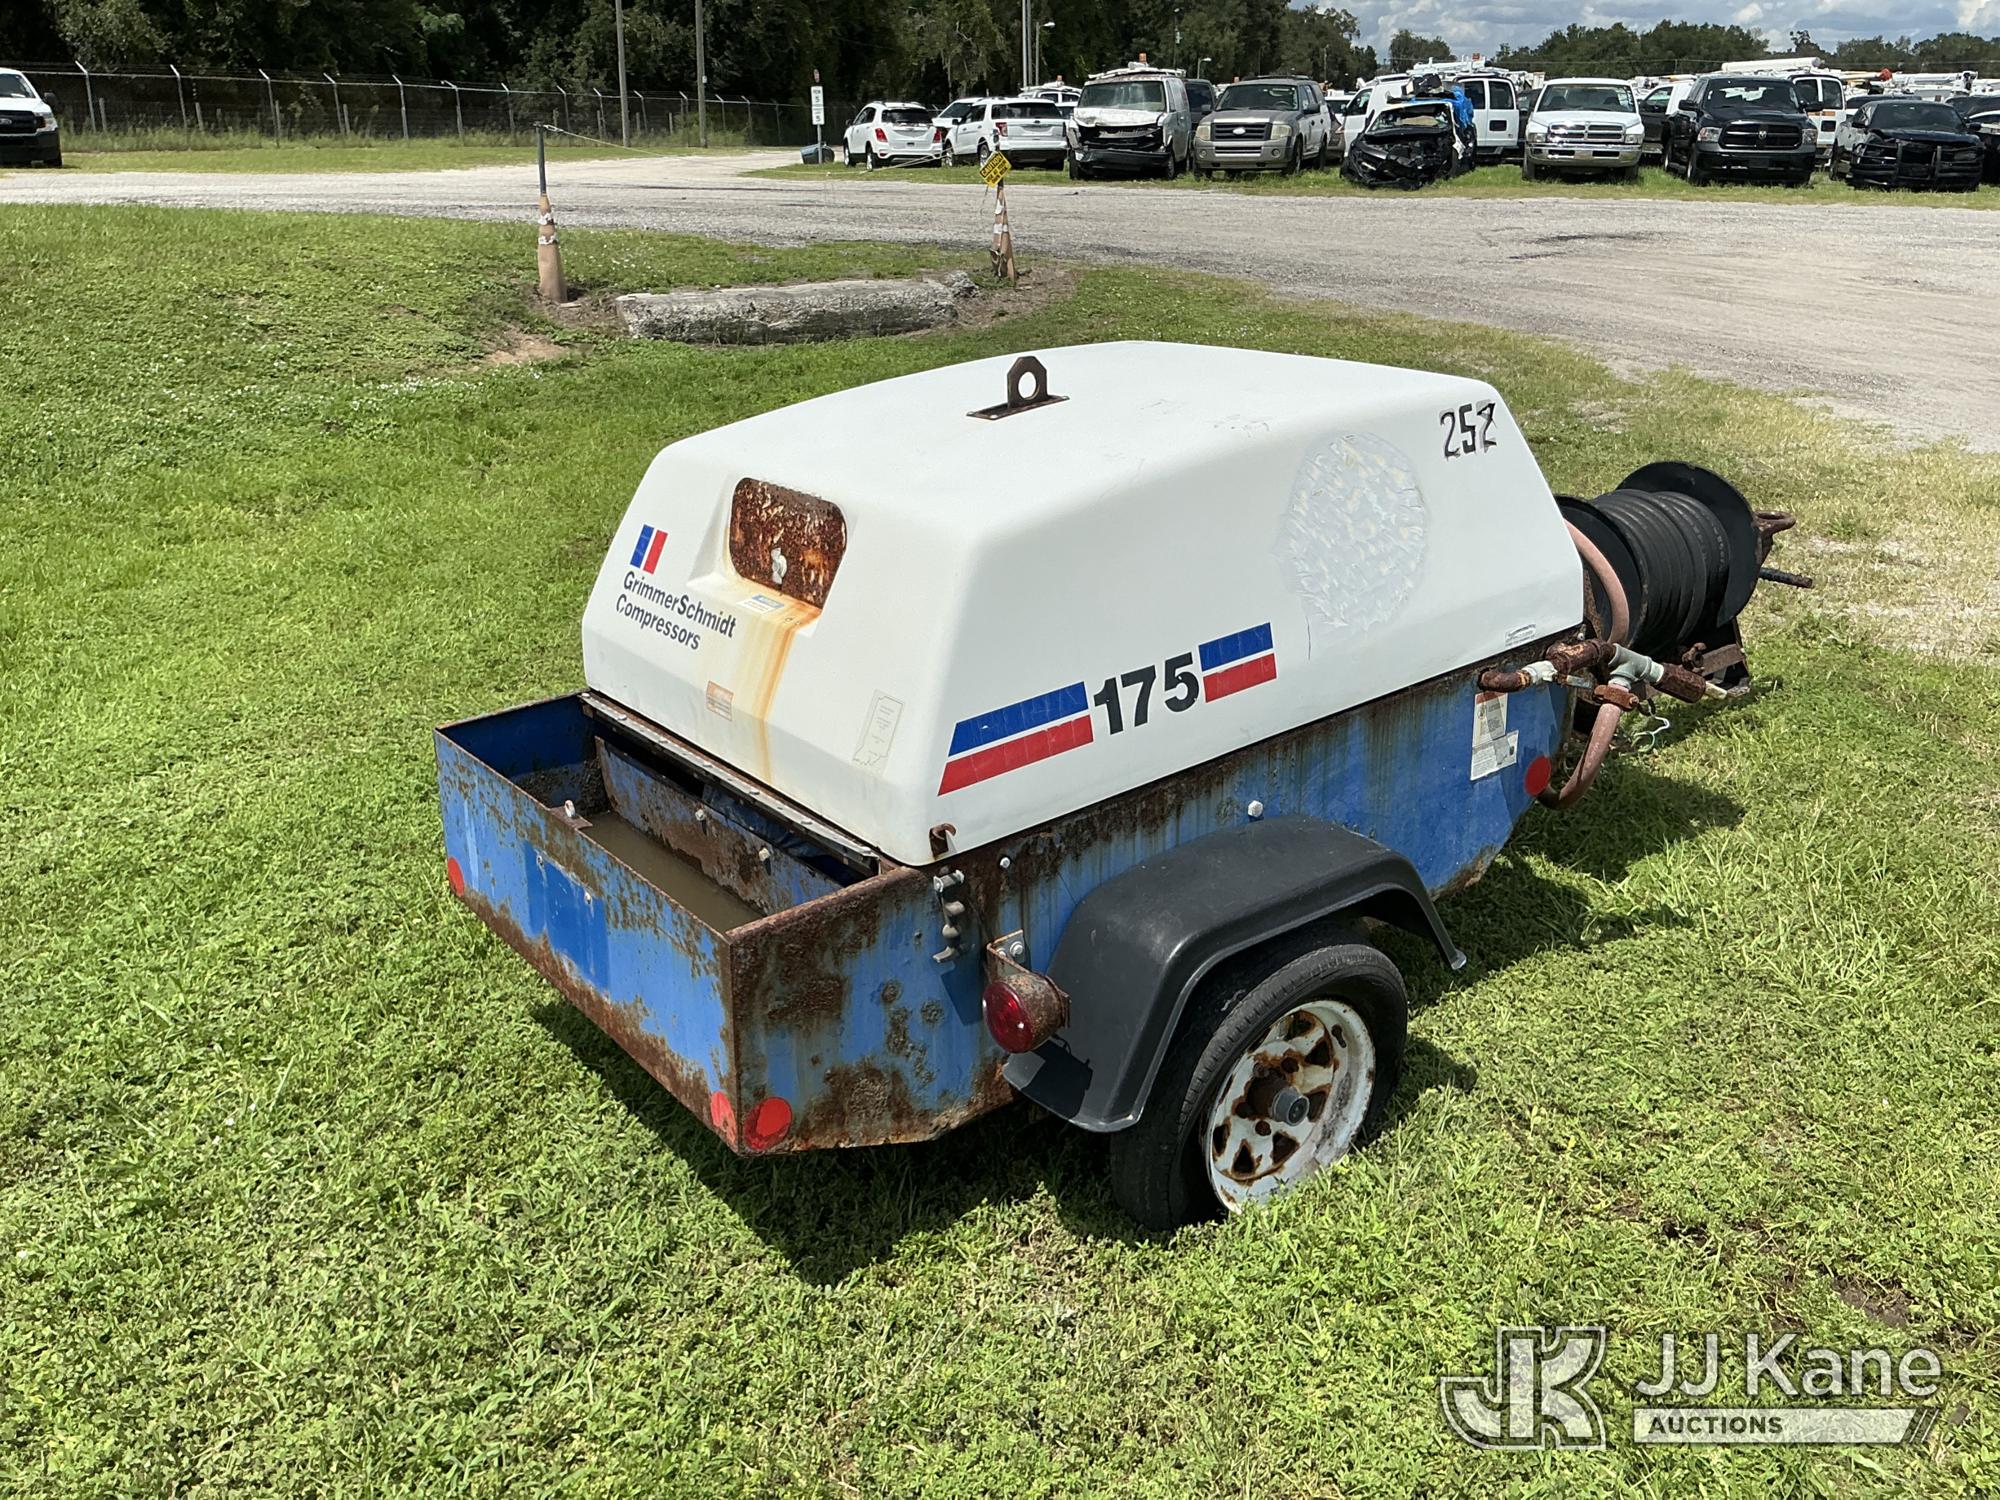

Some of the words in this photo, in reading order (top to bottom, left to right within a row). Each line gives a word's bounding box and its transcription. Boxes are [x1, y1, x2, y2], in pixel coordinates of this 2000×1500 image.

[981, 153, 1003, 176] CAUTION
[616, 594, 701, 650] Compressors
[623, 571, 737, 638] GrimmerSchmidt
[1093, 652, 1200, 735] 175
